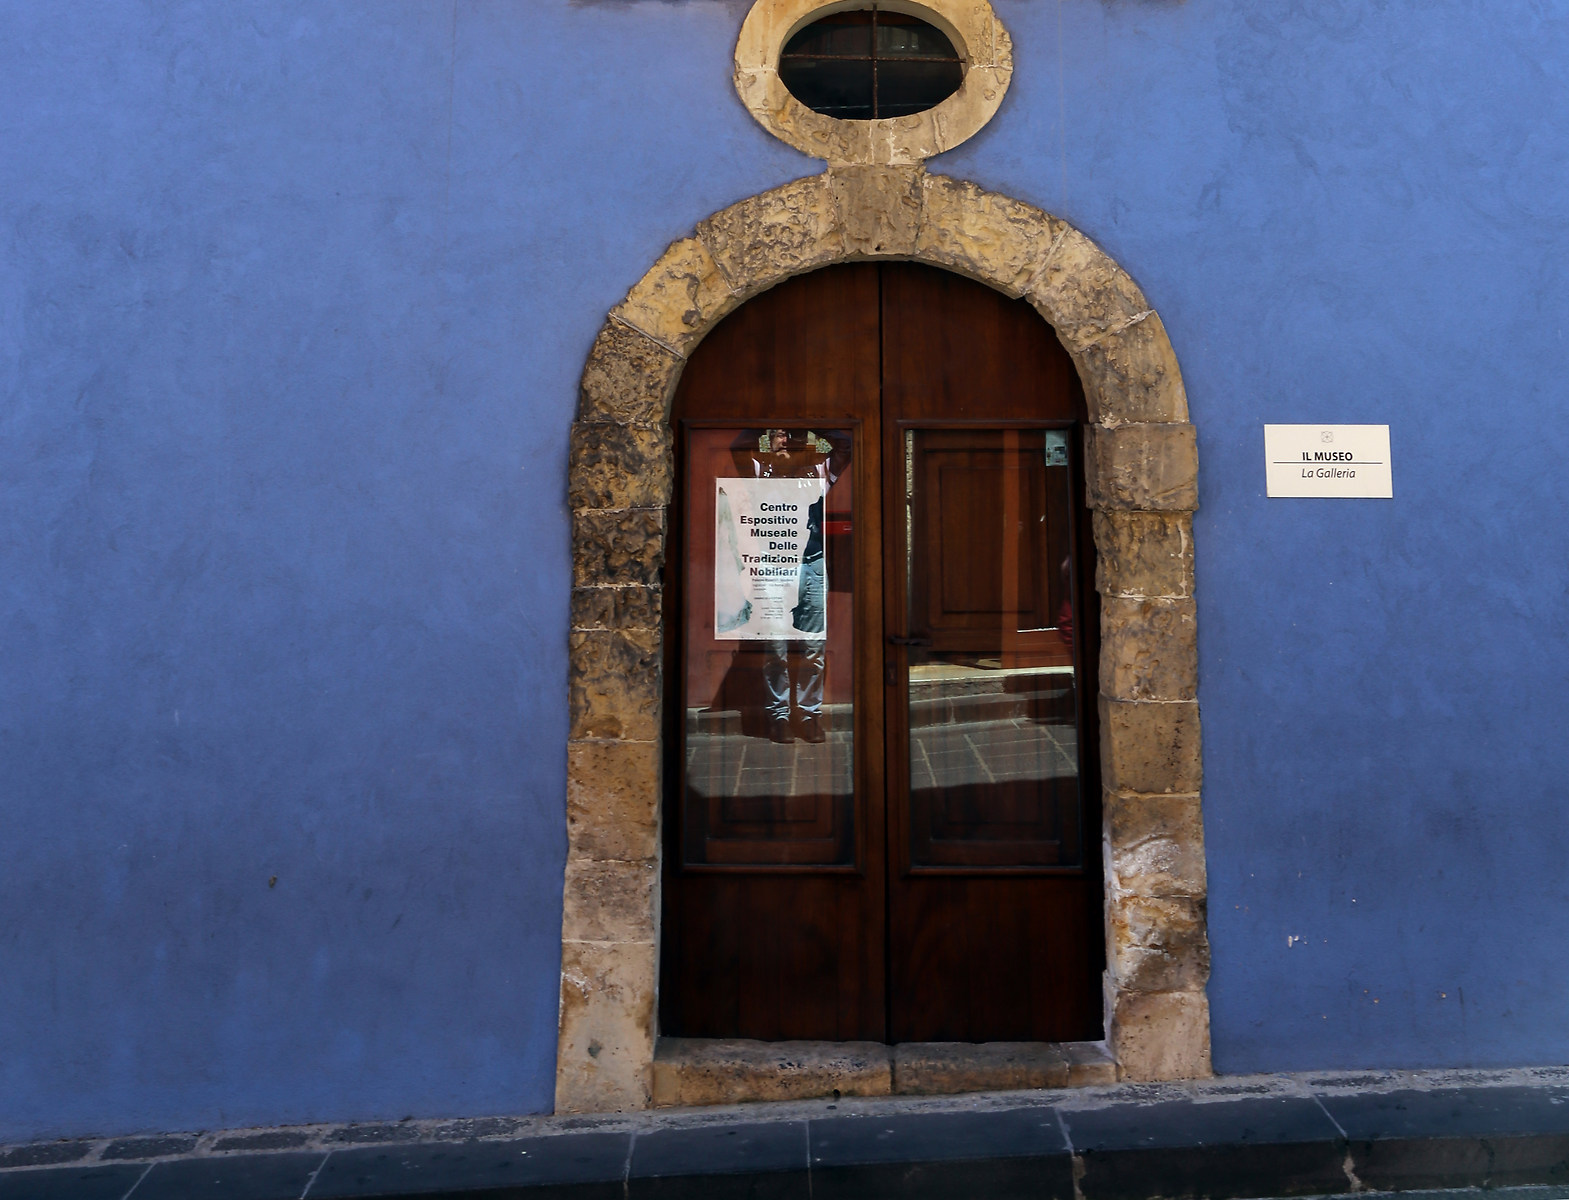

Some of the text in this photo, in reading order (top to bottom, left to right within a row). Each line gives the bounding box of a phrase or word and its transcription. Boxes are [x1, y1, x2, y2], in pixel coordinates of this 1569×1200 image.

[1302, 452, 1353, 461] IL MUSEO
[1302, 468, 1356, 478] La Galleria
[760, 503, 798, 511] Centro
[740, 516, 798, 526] Espositivo
[750, 529, 798, 537] Museale
[769, 542, 798, 550] Delle
[742, 554, 798, 563] Tradizioni
[749, 567, 798, 576] Nobiliari
